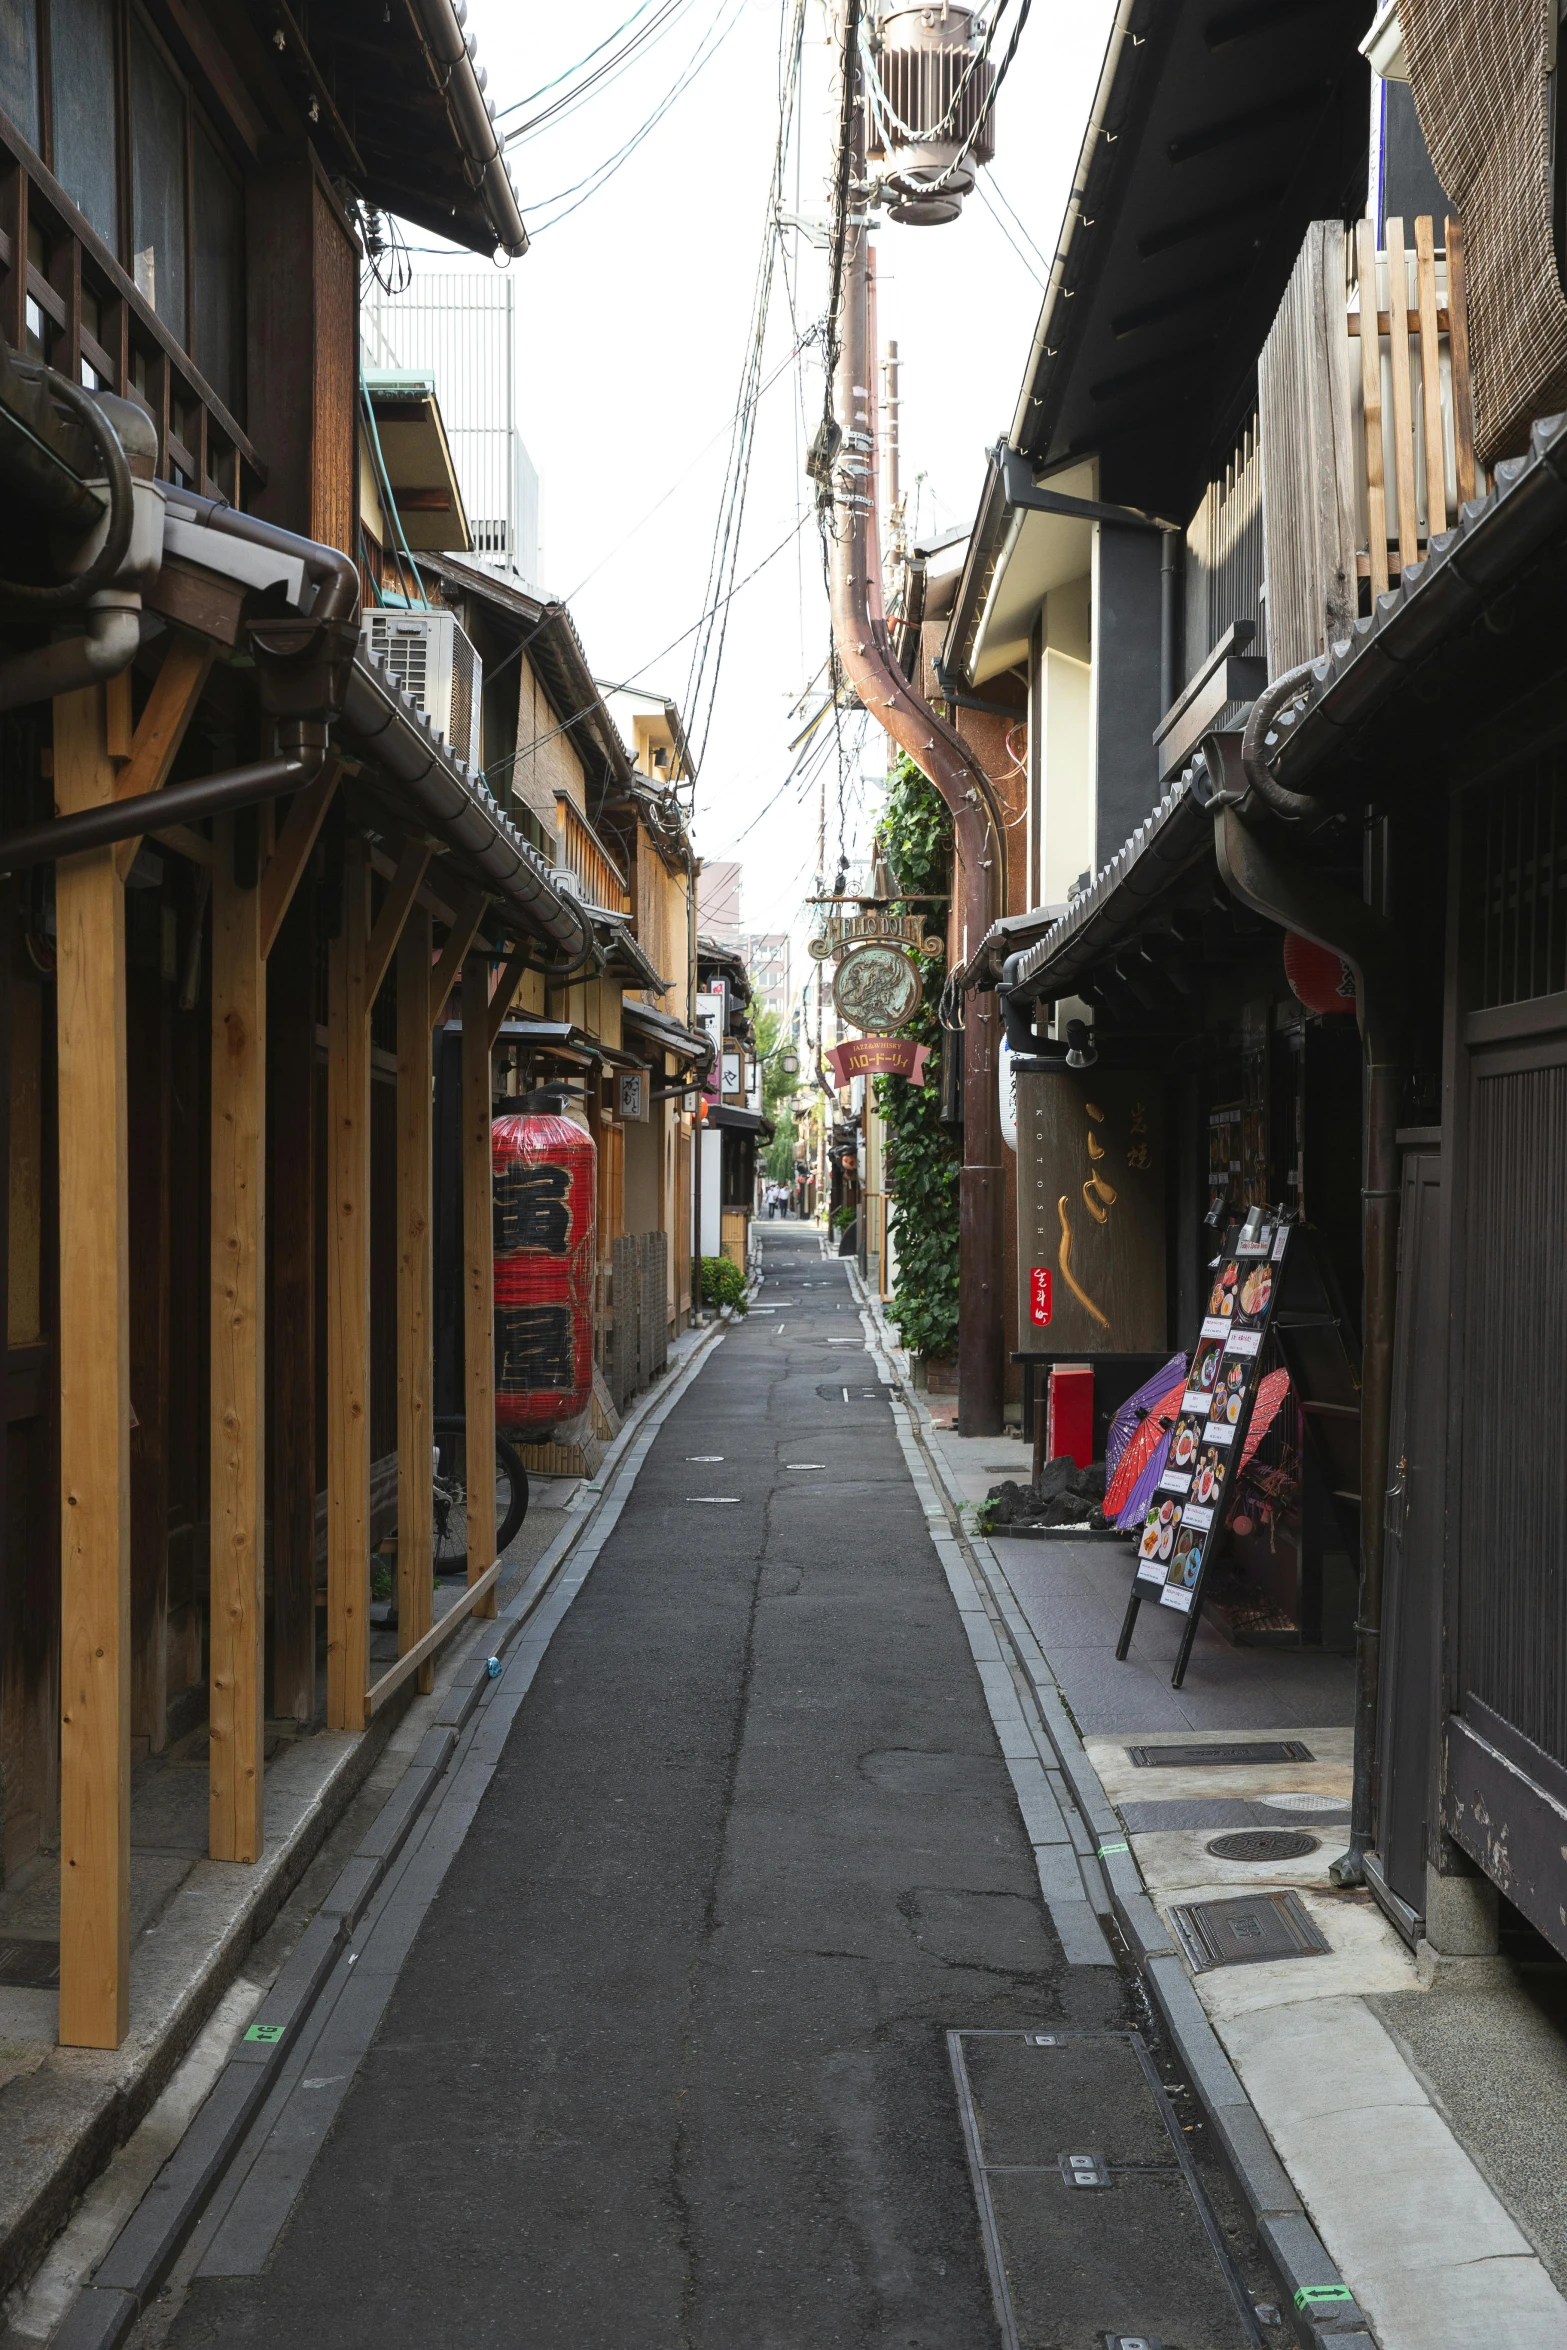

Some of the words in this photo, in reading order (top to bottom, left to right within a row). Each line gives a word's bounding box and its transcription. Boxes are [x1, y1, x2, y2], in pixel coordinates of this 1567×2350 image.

[827, 917, 877, 947] HELLO
[880, 916, 928, 948] DOLLY
[853, 1042, 902, 1053] JAZZ&WHISKY
[849, 1053, 909, 1071] ハロードーリィ
[1036, 1109, 1044, 1256] KOTOSHI
